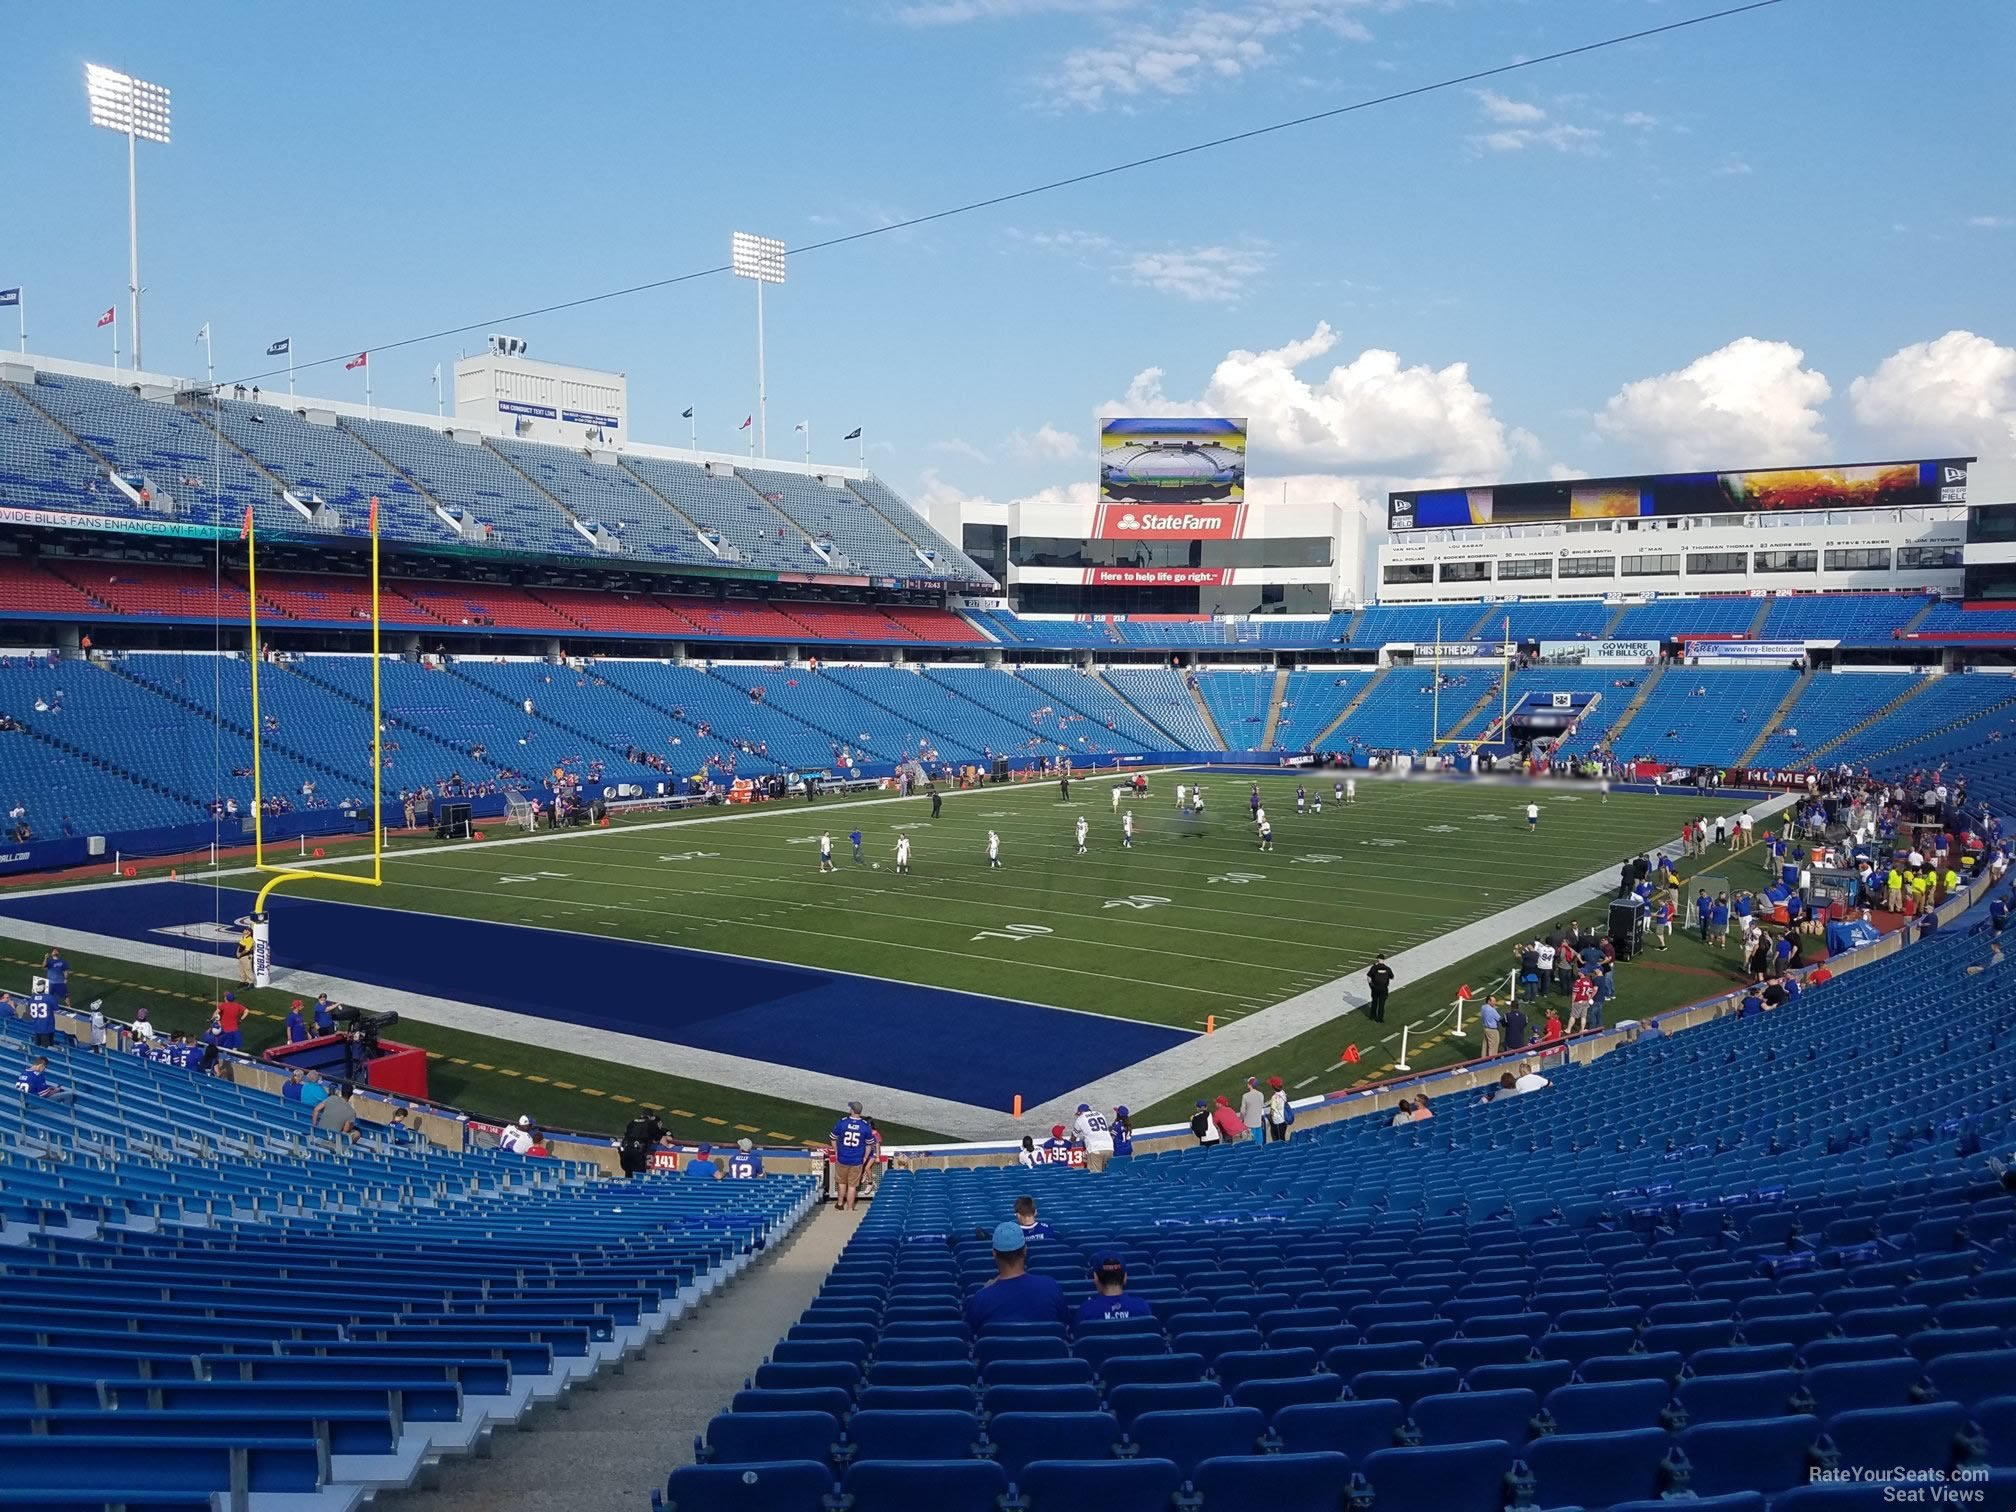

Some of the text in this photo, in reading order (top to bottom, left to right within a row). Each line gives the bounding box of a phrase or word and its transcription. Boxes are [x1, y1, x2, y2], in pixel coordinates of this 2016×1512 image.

[35, 513, 66, 526] BILLS
[70, 516, 102, 528] FANS
[104, 519, 166, 533] ENHANCED
[1100, 572, 1122, 581] Here
[1123, 572, 1134, 581] to
[1135, 572, 1156, 583] help
[1157, 572, 1173, 581] life
[1174, 574, 1186, 582] go
[1414, 645, 1434, 656] THIS
[1443, 645, 1460, 656] THE
[1460, 645, 1478, 656] CAP
[1597, 649, 1655, 658] THE BILLS GO.
[1602, 642, 1648, 650] GO WHERE
[1724, 645, 1805, 654] www.Frey-Electric.com
[1102, 894, 1172, 910] 20
[970, 923, 1054, 941] 10
[256, 939, 268, 977] FOOTBALL
[30, 1002, 48, 1019] 83
[180, 1055, 187, 1068] 5
[1087, 1116, 1109, 1132] 99
[843, 1130, 861, 1148] 25
[1051, 1146, 1067, 1161] 95
[654, 1154, 676, 1169] 141
[730, 1163, 753, 1179] 12
